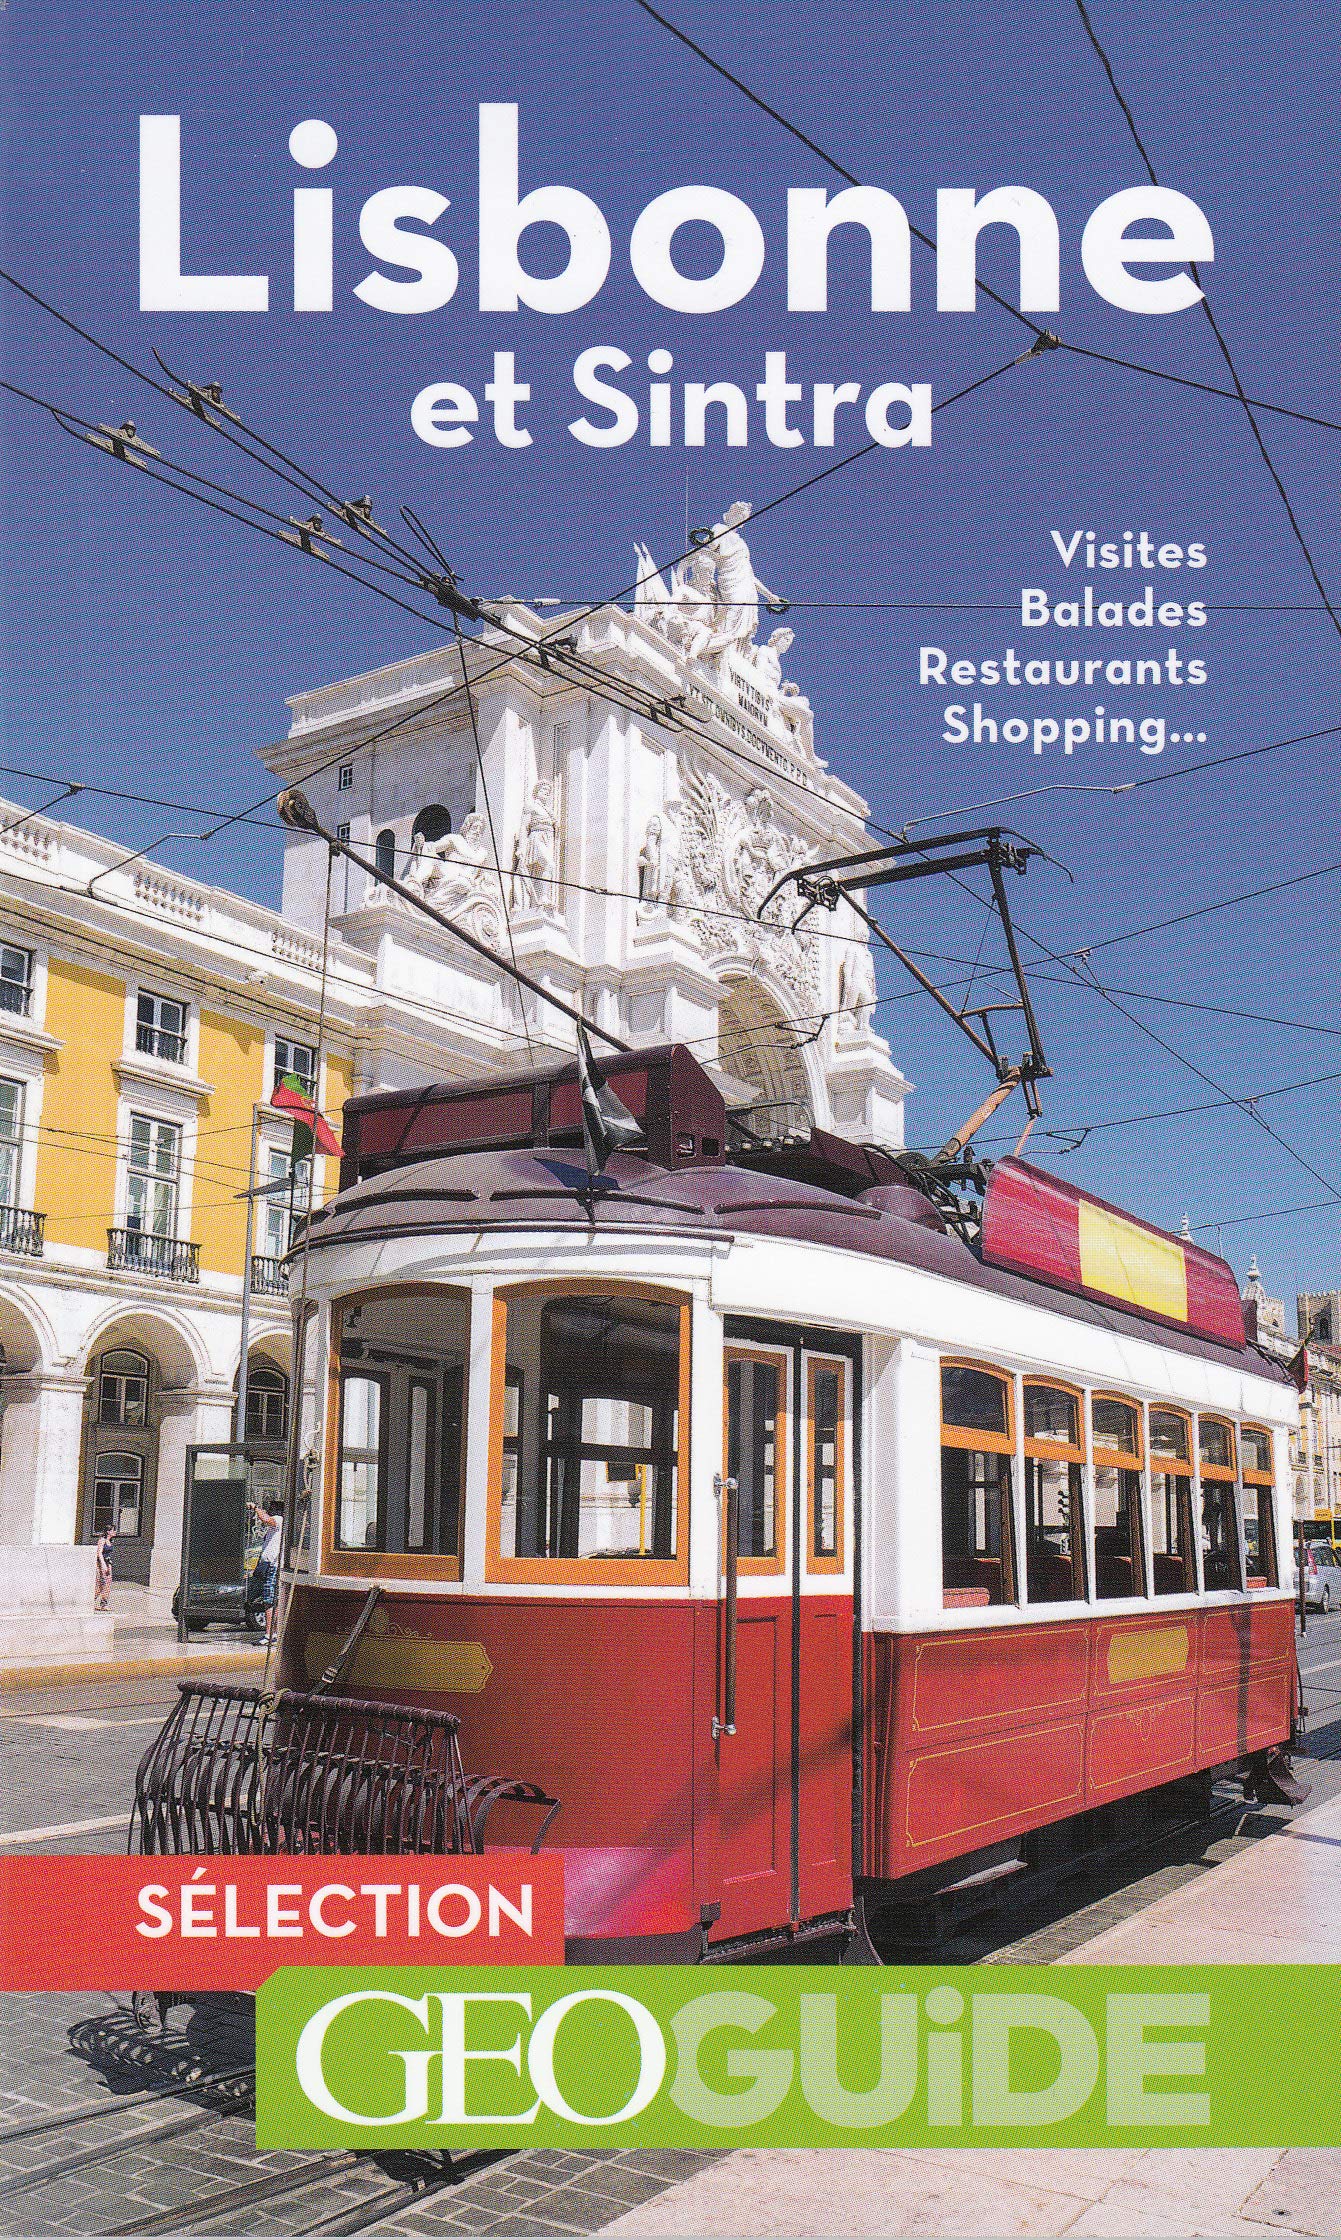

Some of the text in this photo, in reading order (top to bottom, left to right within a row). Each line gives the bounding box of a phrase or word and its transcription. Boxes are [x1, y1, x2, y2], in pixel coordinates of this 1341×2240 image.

[138, 102, 1215, 315] Lisbonne
[410, 345, 933, 449] et Sintra
[1049, 529, 1208, 570] Visites
[1021, 585, 1208, 628] Balades
[919, 646, 1208, 686] Restaurants
[941, 702, 1208, 756] Shopping...
[134, 1867, 534, 1940] SÉLECTION
